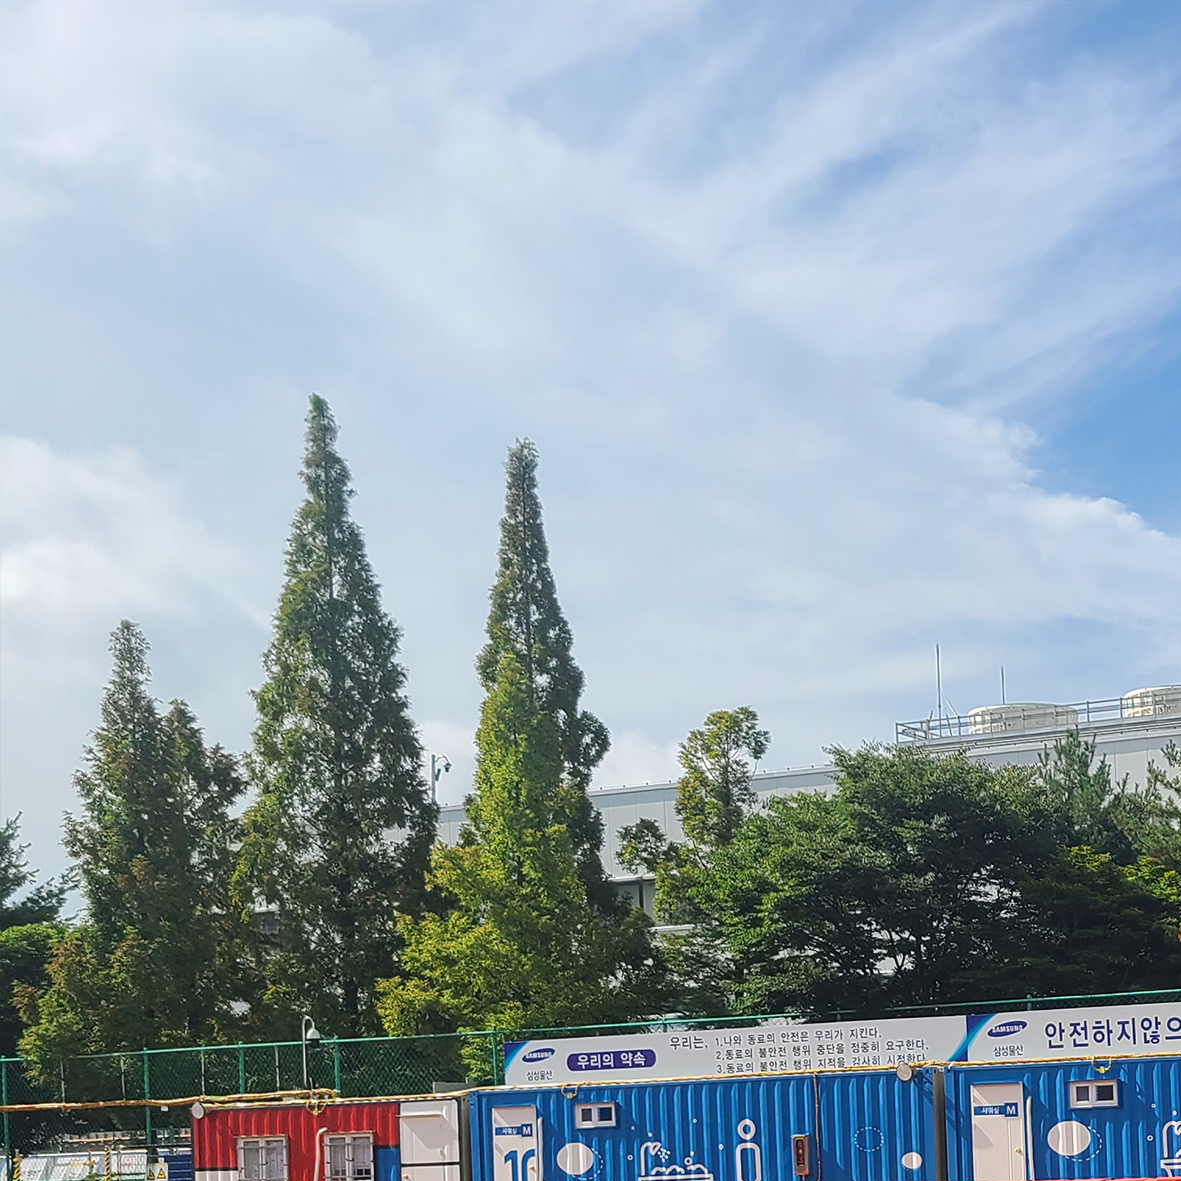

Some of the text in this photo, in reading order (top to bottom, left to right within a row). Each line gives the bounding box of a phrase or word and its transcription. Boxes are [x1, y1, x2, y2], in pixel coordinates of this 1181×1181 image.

[990, 1022, 1025, 1035] SAMSUNG
[670, 1035, 708, 1050] 우리는,
[715, 1027, 882, 1047] 1.나와 동료의 안전은 우리가 지킨다.
[716, 1039, 929, 1060] 2.동료의 불안전 행위 중단을 정중히 요구한다.
[994, 1045, 1023, 1057] 삼성물산
[577, 1051, 646, 1069] 우리의 약속
[716, 1062, 754, 1074] 3.동료의
[760, 1060, 788, 1072] 불안전
[1006, 1105, 1016, 1115] M
[522, 1126, 531, 1135] M
